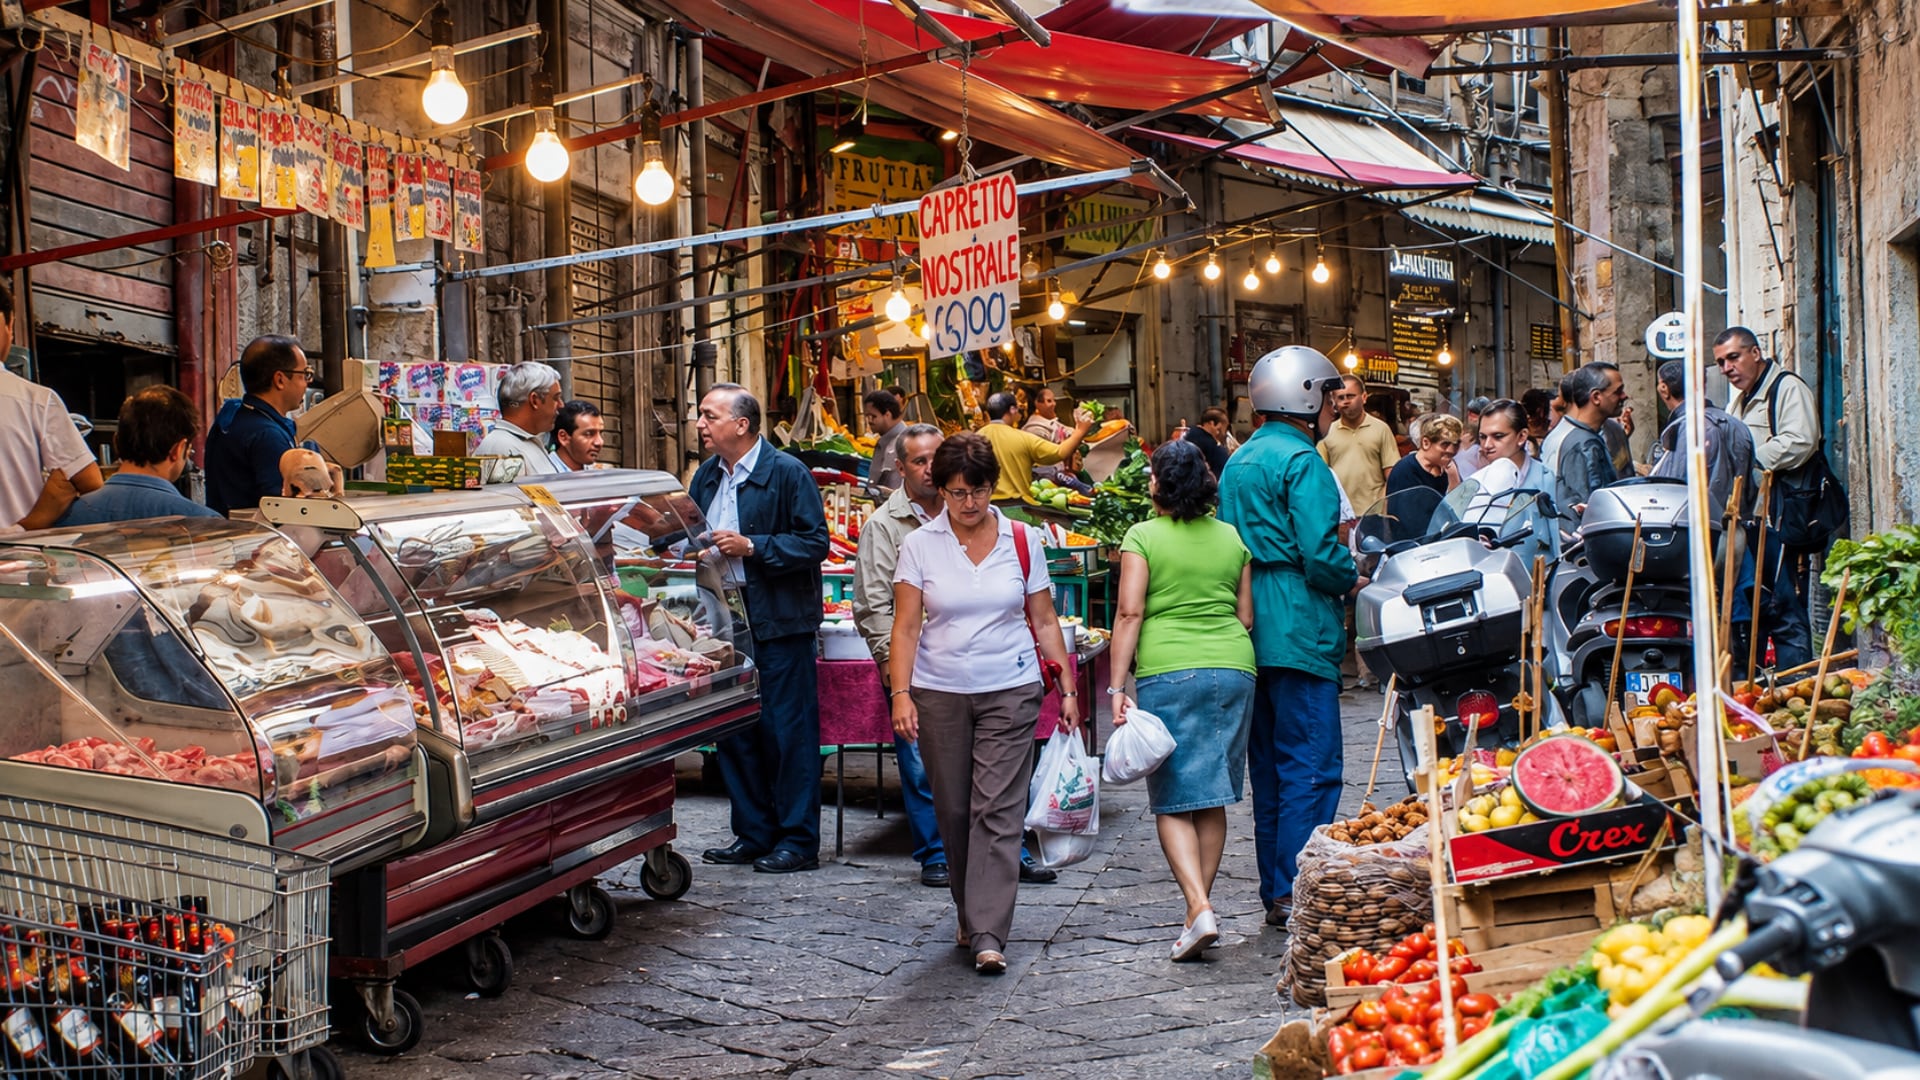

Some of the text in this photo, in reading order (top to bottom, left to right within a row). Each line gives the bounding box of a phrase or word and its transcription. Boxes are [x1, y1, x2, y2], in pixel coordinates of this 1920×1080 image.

[919, 174, 1017, 240] CAPRETTO
[921, 234, 1019, 301] NOSTRALE
[1548, 817, 1647, 857] Crex
